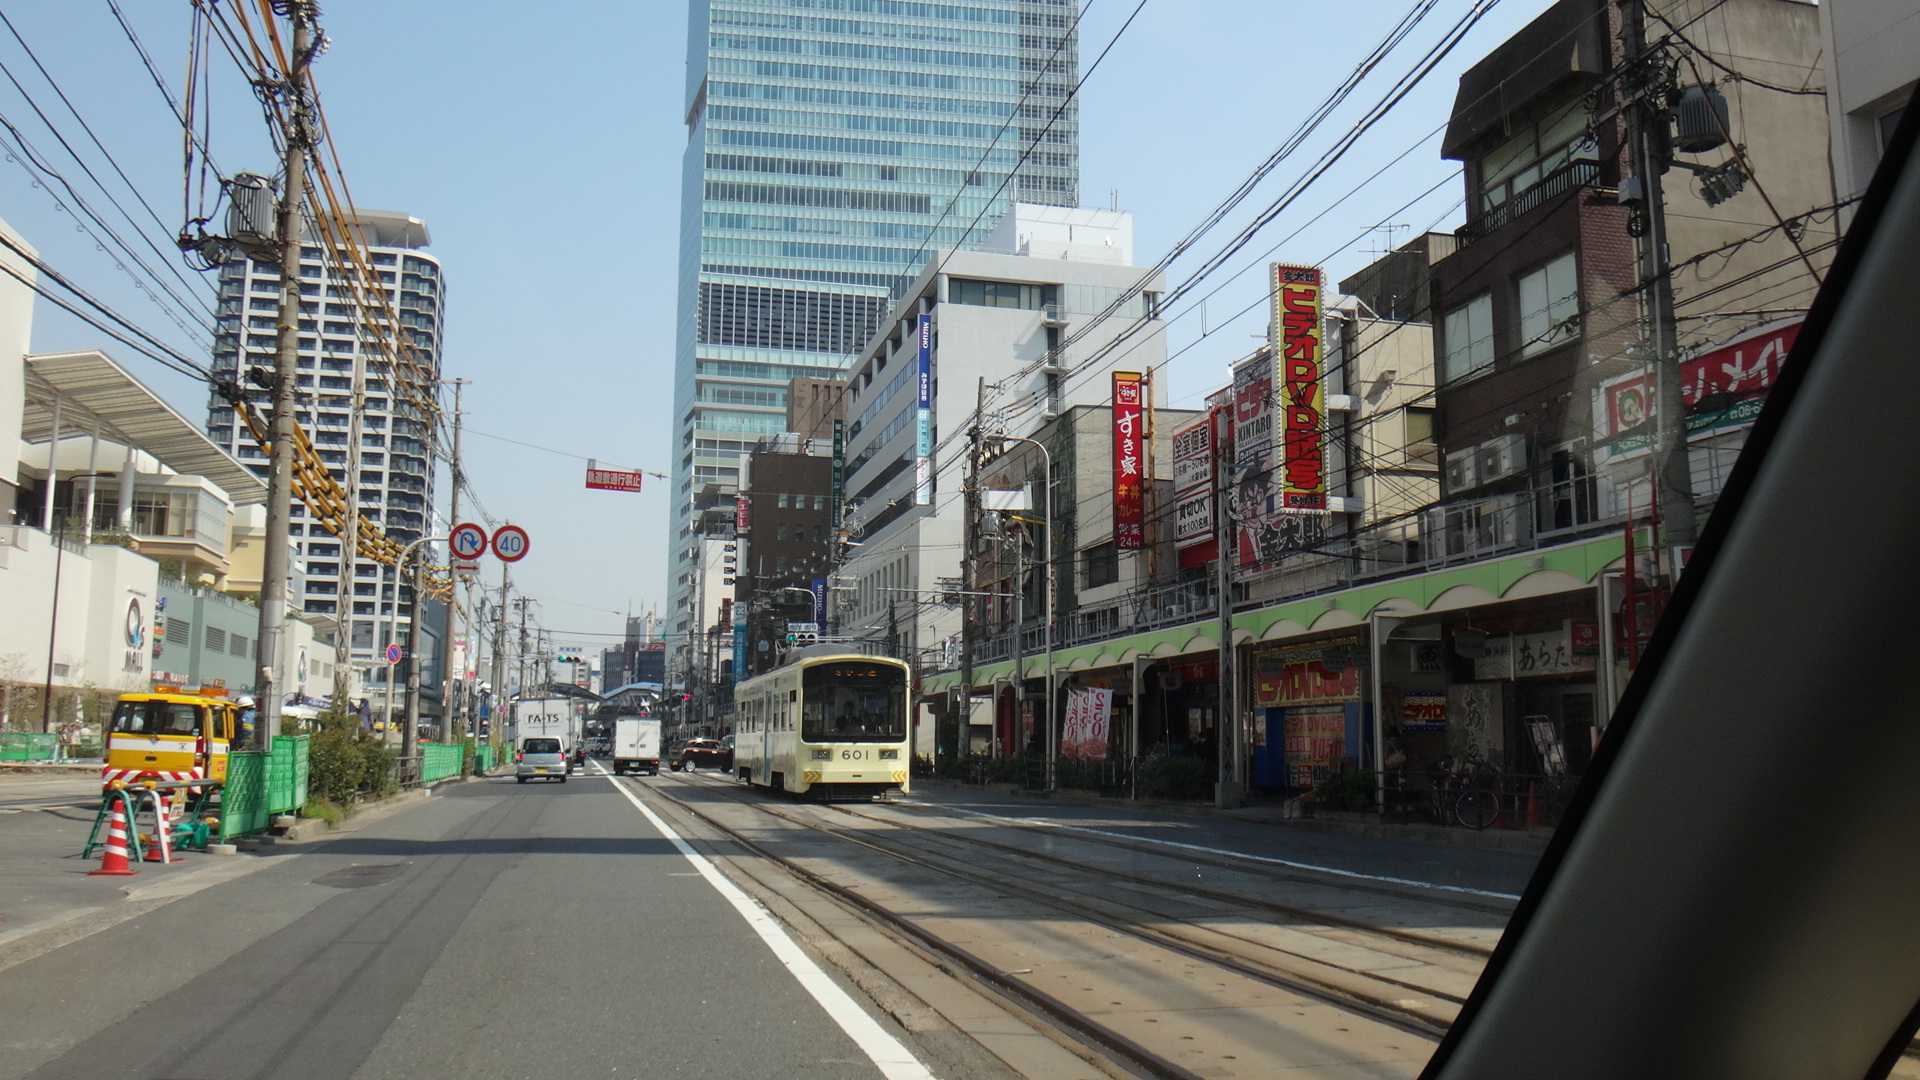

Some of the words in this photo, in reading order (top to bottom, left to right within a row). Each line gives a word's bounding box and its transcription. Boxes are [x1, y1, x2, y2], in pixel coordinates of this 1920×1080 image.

[1284, 271, 1315, 283] 金太郎
[922, 322, 930, 349] MIZUHO
[1238, 414, 1272, 443] KINTARO
[1117, 410, 1139, 478] すき家
[1174, 425, 1208, 460] 全室個室
[1118, 484, 1140, 500] 牛丼
[1118, 504, 1140, 517] カレー
[500, 536, 521, 552] 40
[841, 749, 869, 761] 601
